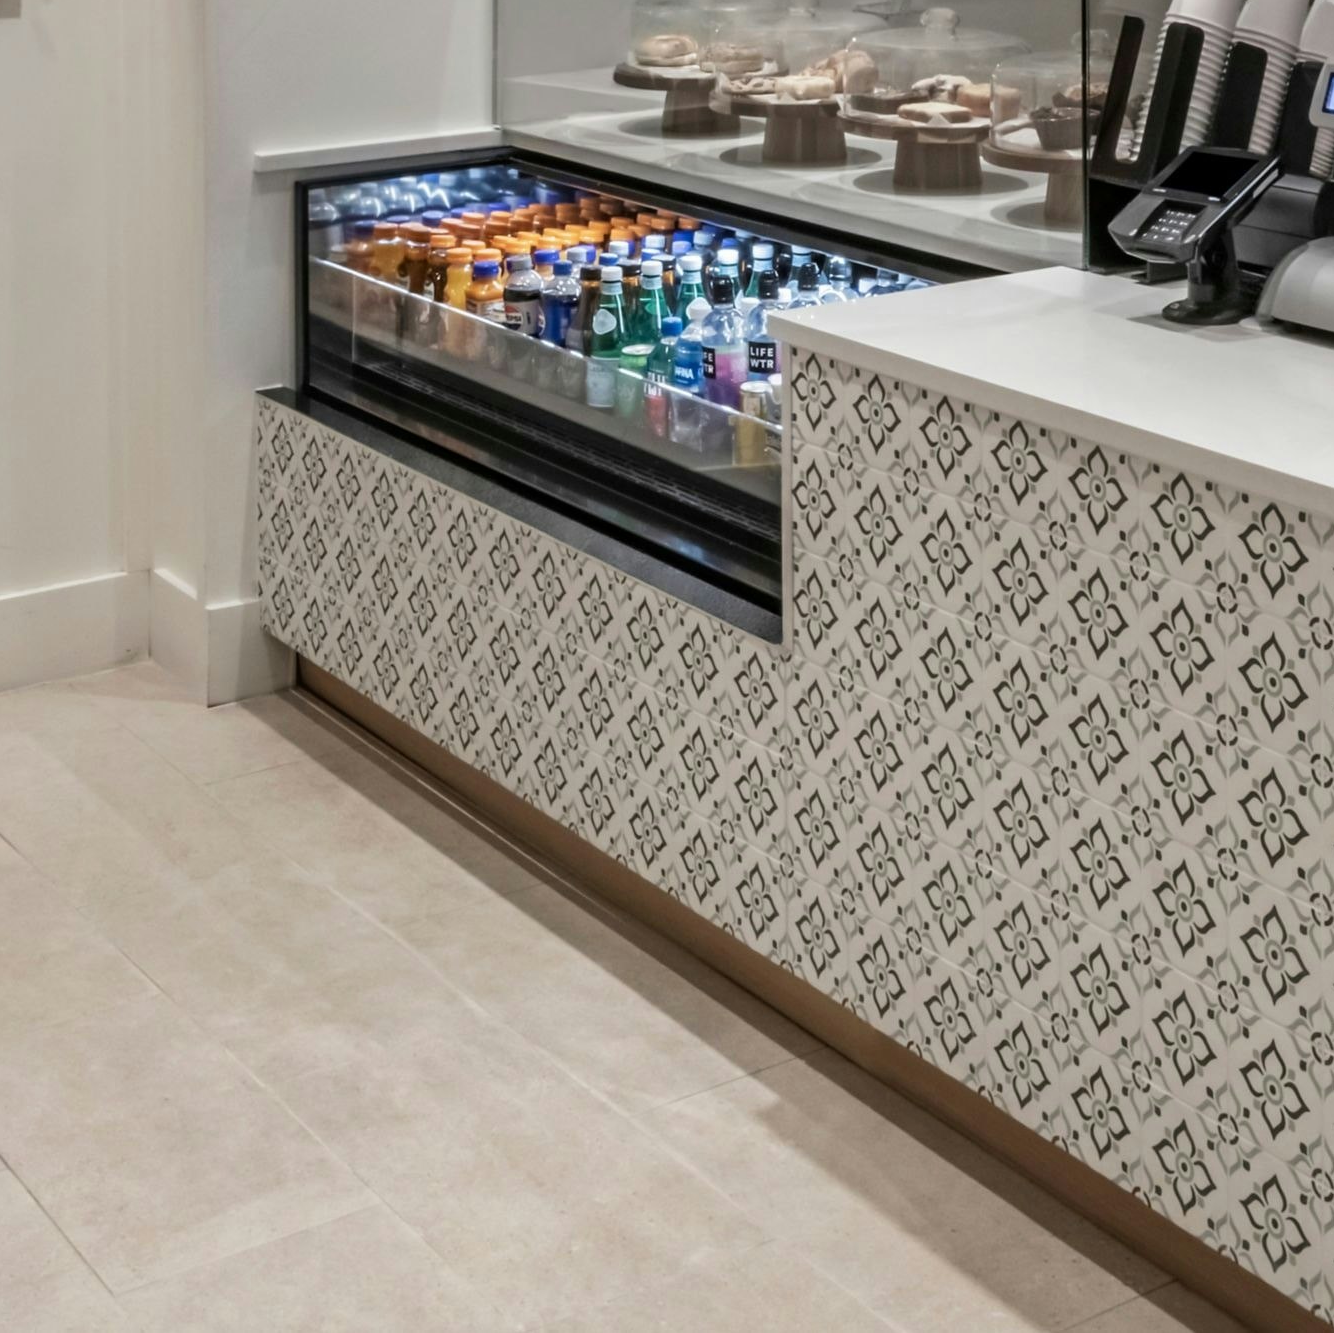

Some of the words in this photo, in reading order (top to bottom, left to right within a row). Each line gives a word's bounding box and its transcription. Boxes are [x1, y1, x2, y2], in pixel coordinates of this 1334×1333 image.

[749, 346, 774, 358] LIFE
[703, 363, 714, 374] TR
[749, 358, 774, 369] WTR
